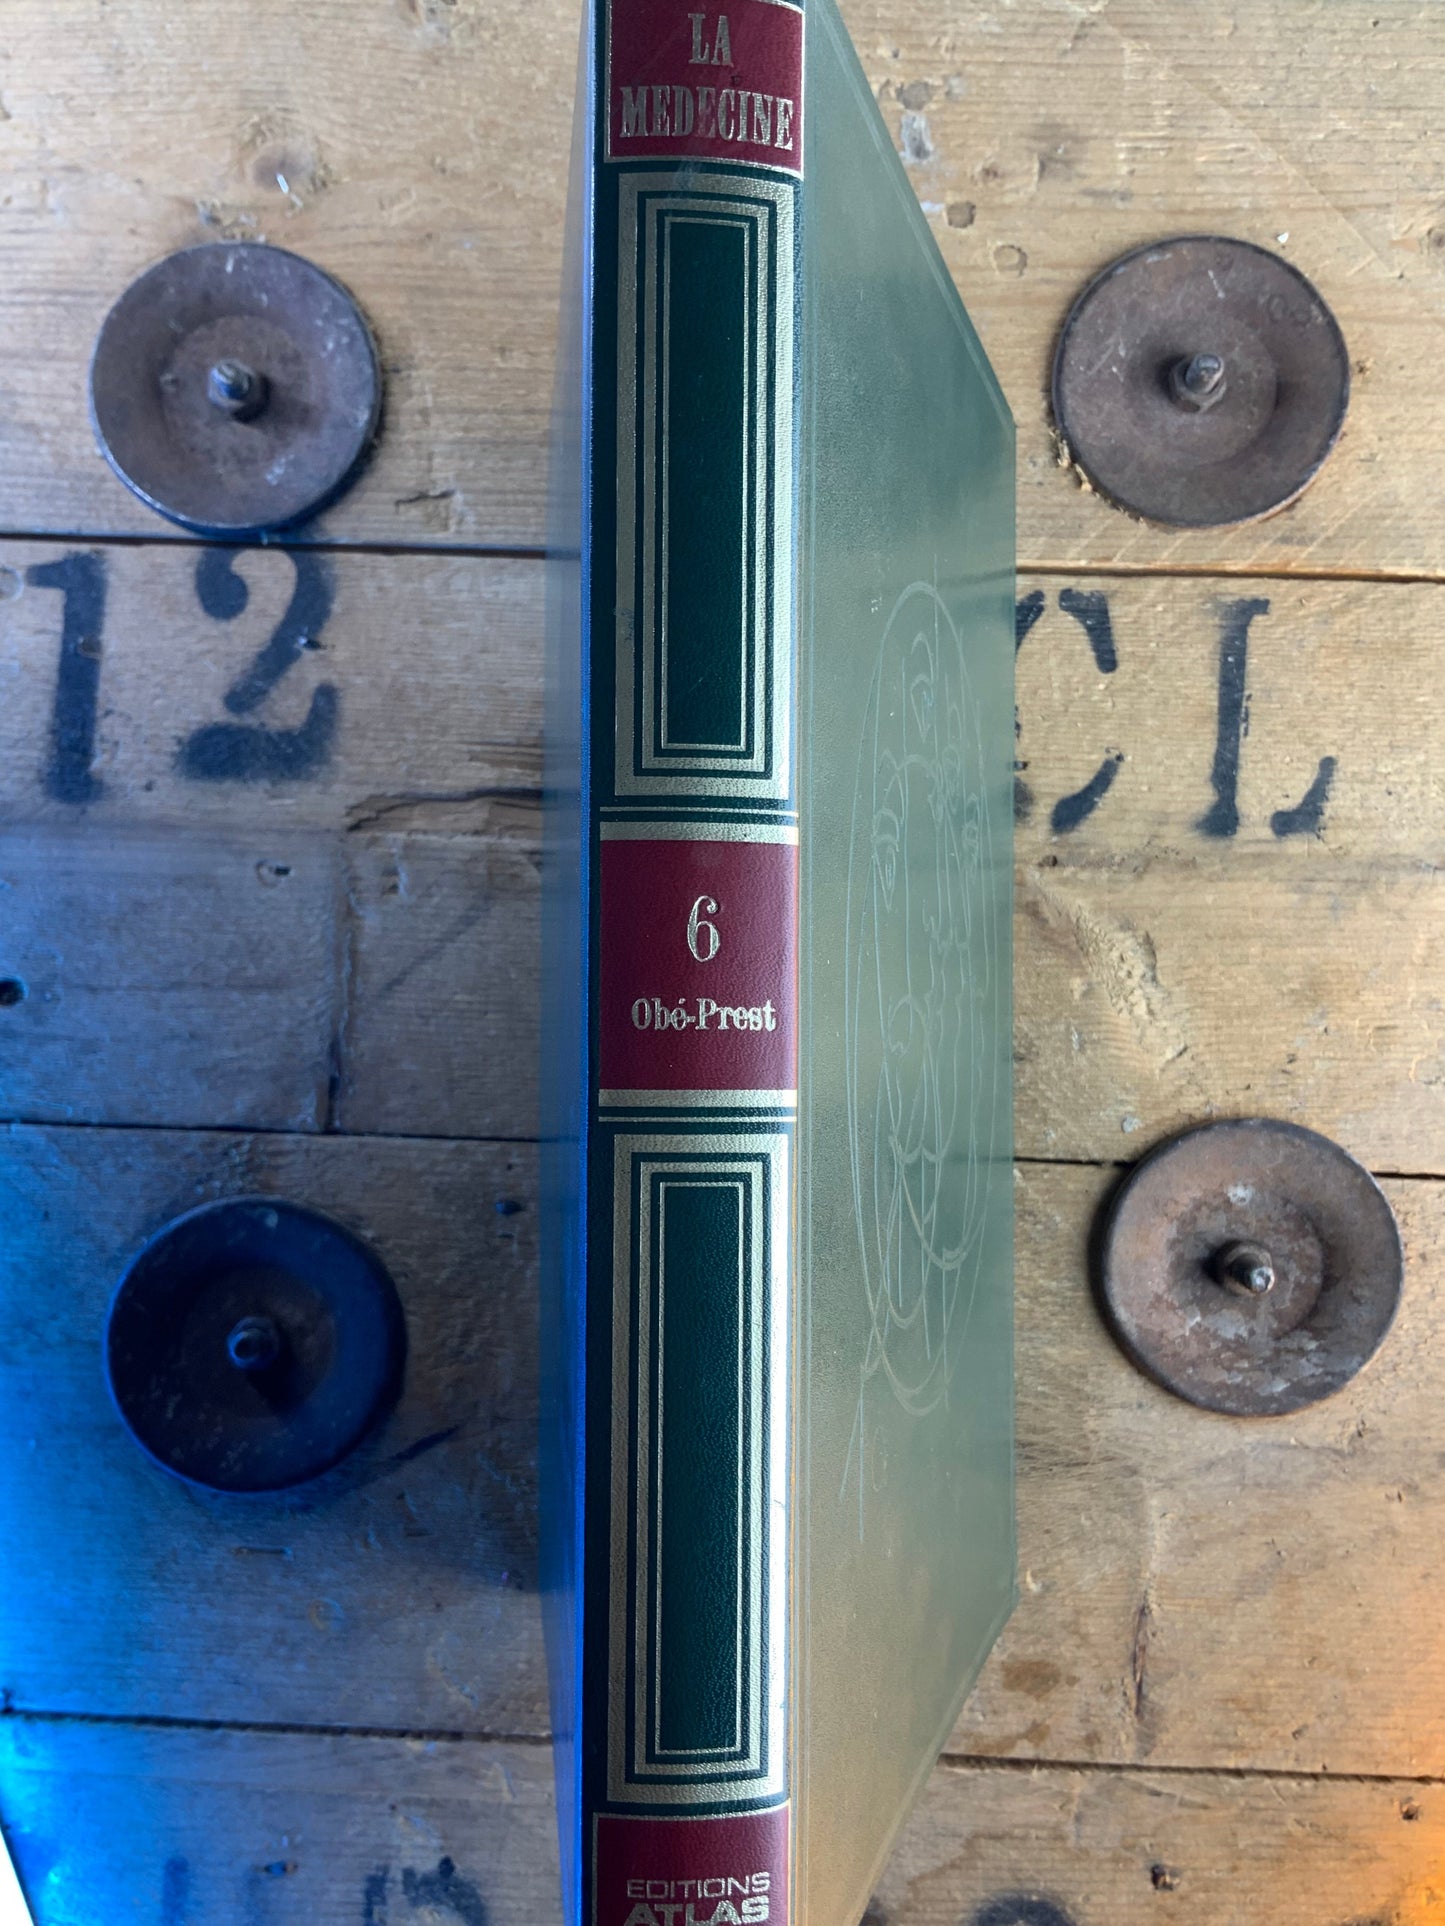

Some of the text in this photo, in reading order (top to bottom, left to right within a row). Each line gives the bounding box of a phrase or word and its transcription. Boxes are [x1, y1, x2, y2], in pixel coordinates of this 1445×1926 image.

[688, 13, 734, 67] LA
[619, 85, 794, 151] MEDECINE
[687, 895, 721, 962] 6
[631, 998, 777, 1032] Obé-Prest
[626, 1871, 771, 1899] EDITIONS
[622, 1895, 770, 1926] ATLAS
